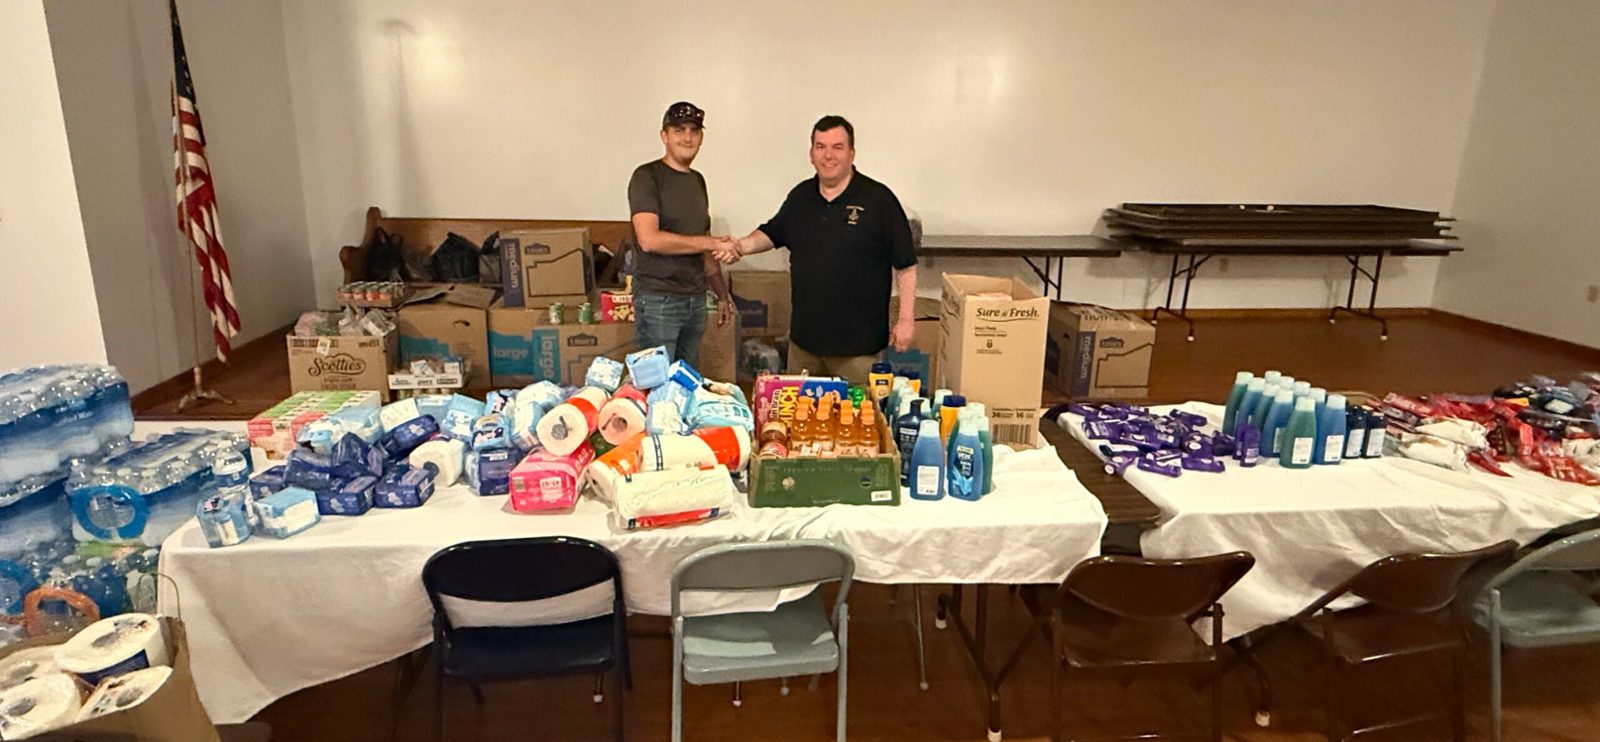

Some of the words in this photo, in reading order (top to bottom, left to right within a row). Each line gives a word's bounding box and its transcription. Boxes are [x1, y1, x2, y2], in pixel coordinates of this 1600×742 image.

[504, 243, 519, 288] medium
[976, 307, 1000, 317] Sure
[1010, 306, 1038, 317] Fresh
[308, 357, 363, 377] Scotties
[492, 345, 529, 361] large
[540, 335, 558, 379] large
[779, 386, 800, 422] UNCH
